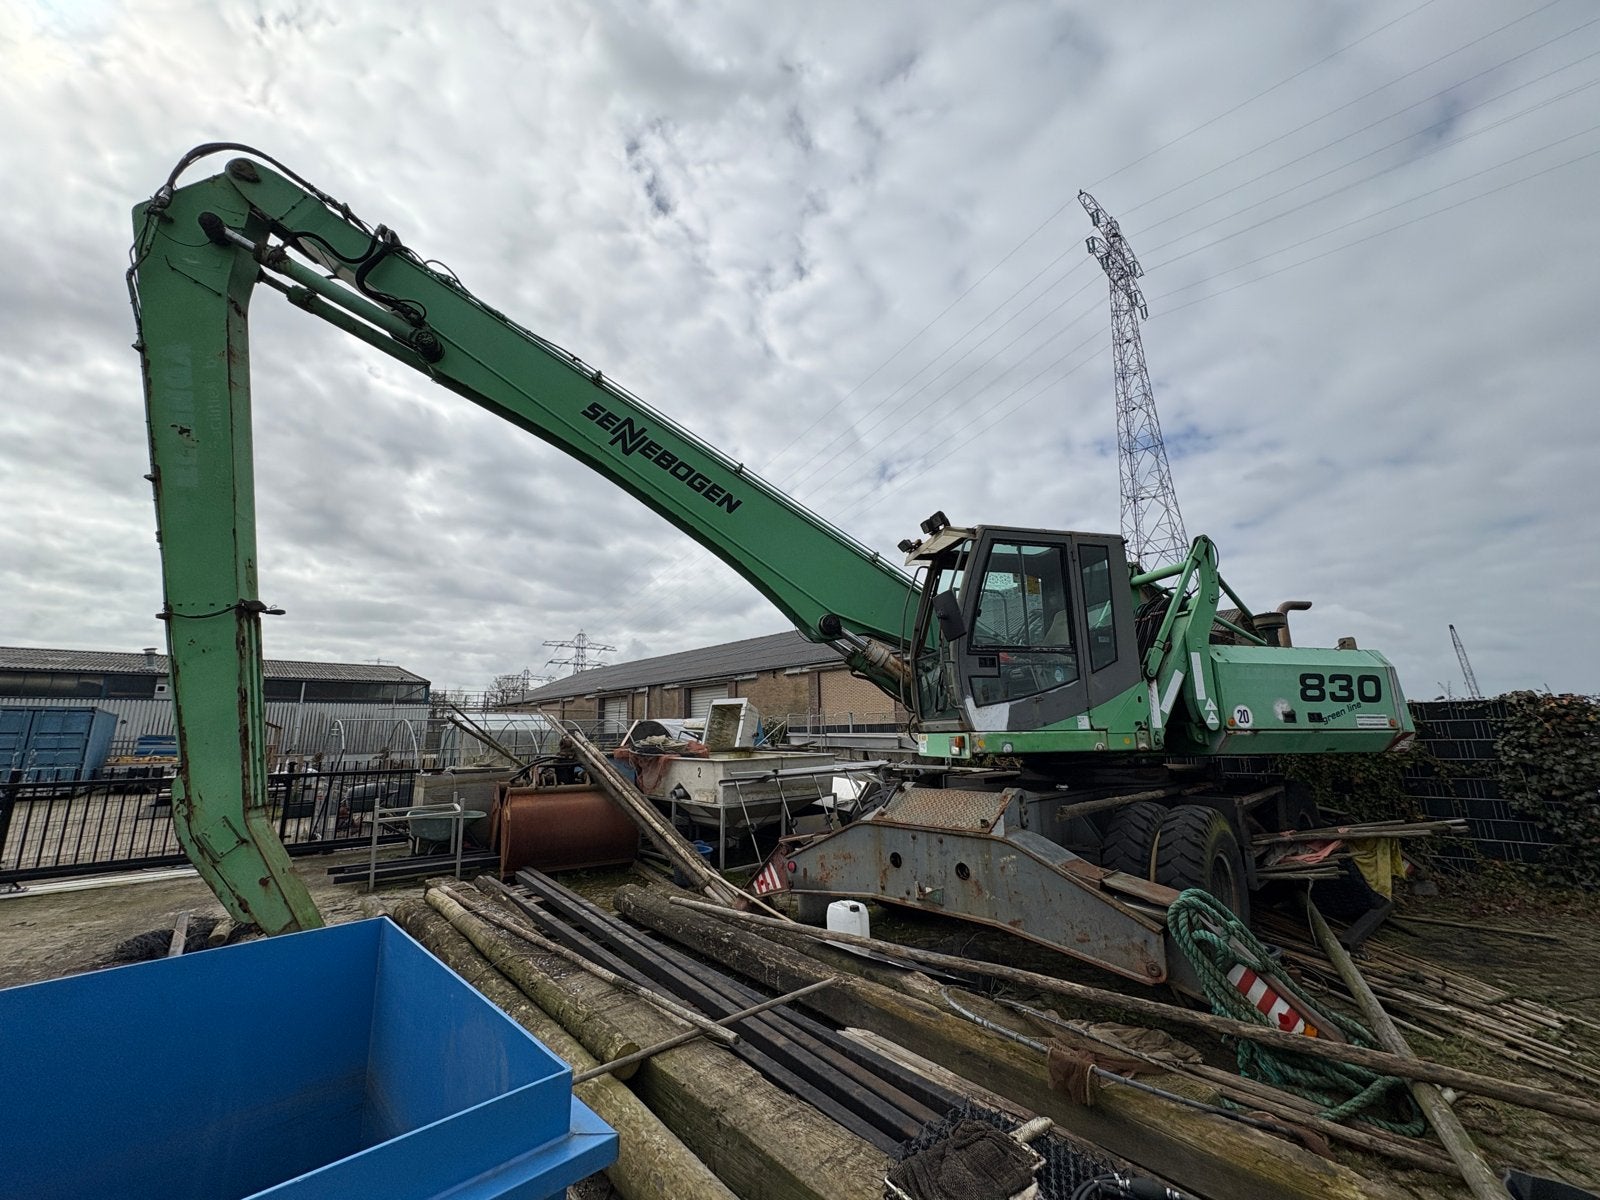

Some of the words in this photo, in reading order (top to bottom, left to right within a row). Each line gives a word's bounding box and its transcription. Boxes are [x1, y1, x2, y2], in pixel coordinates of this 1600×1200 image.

[580, 401, 743, 514] SENNEBOGEN
[1299, 673, 1382, 703] 830
[1236, 709, 1250, 723] 20
[1322, 708, 1346, 725] green
[1346, 702, 1362, 713] line
[697, 766, 702, 778] 2
